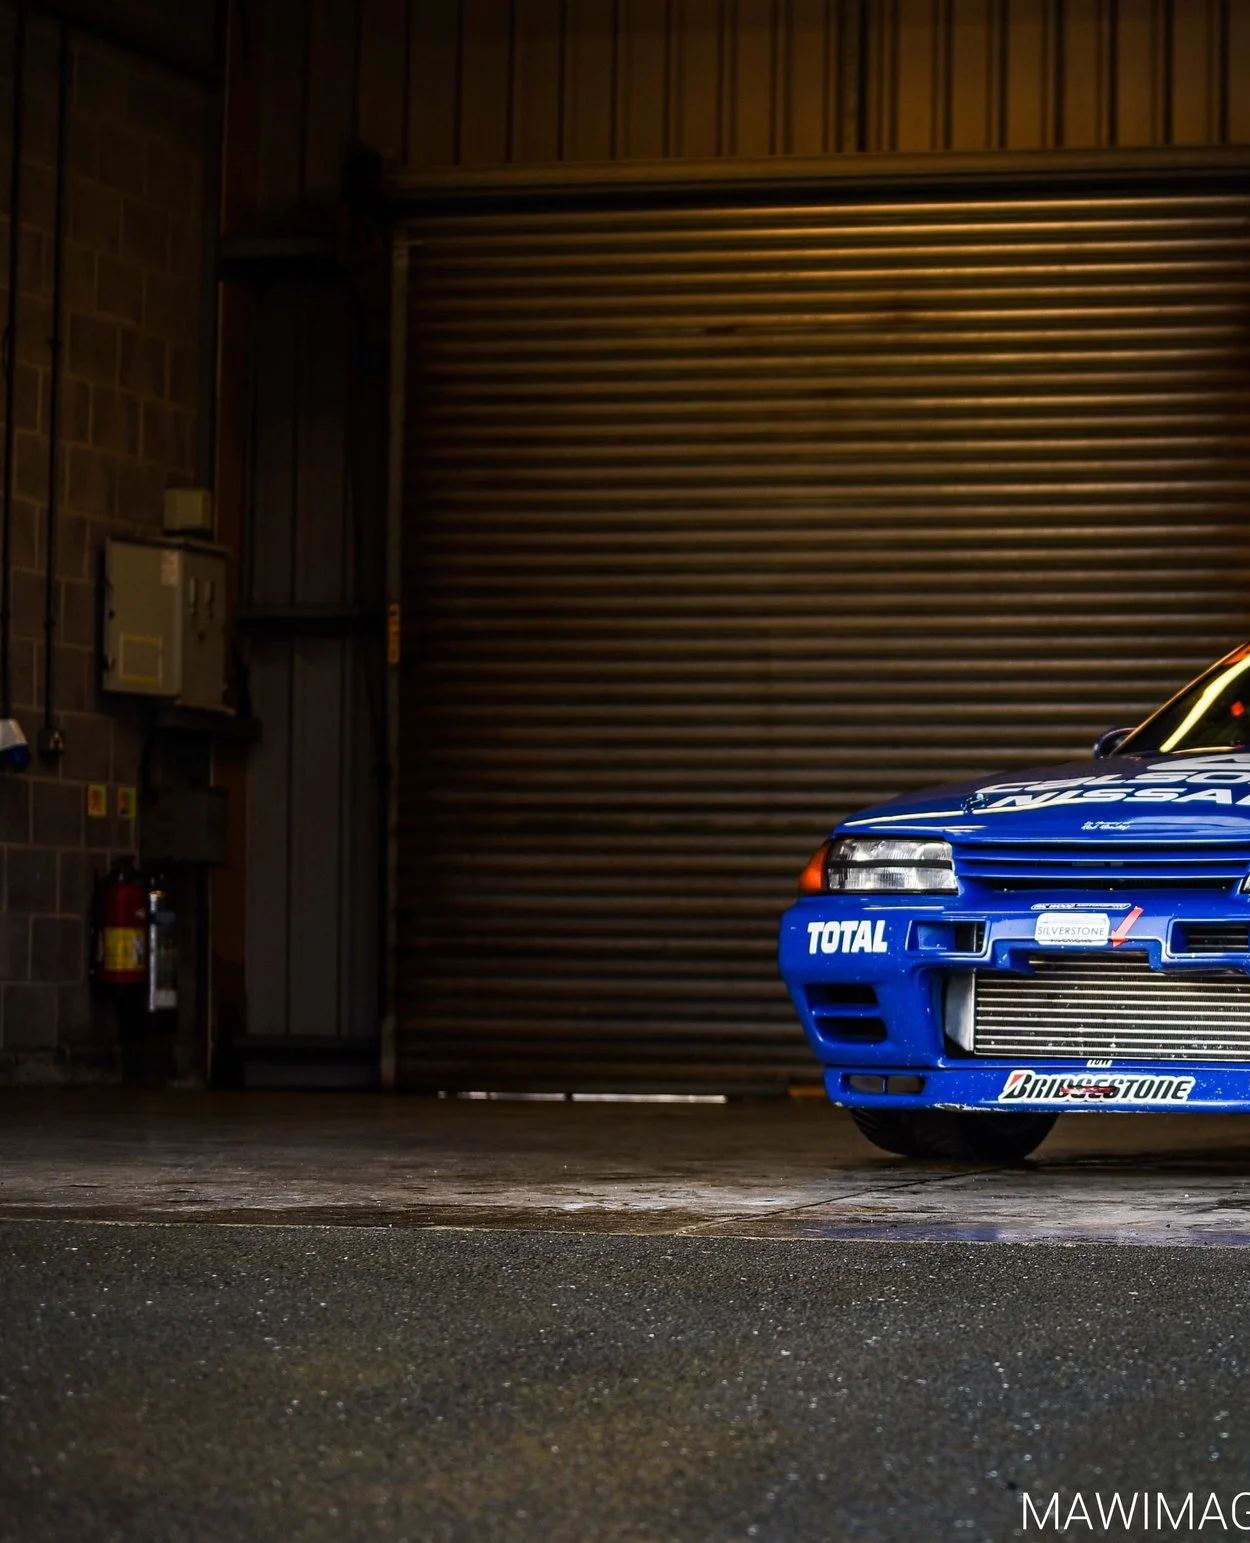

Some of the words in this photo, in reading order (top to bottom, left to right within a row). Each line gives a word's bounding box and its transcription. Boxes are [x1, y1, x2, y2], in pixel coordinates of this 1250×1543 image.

[807, 920, 887, 954] TOTAL
[1037, 926, 1105, 936] SILVERSTONE
[1002, 1074, 1192, 1100] BRIDGESTONE
